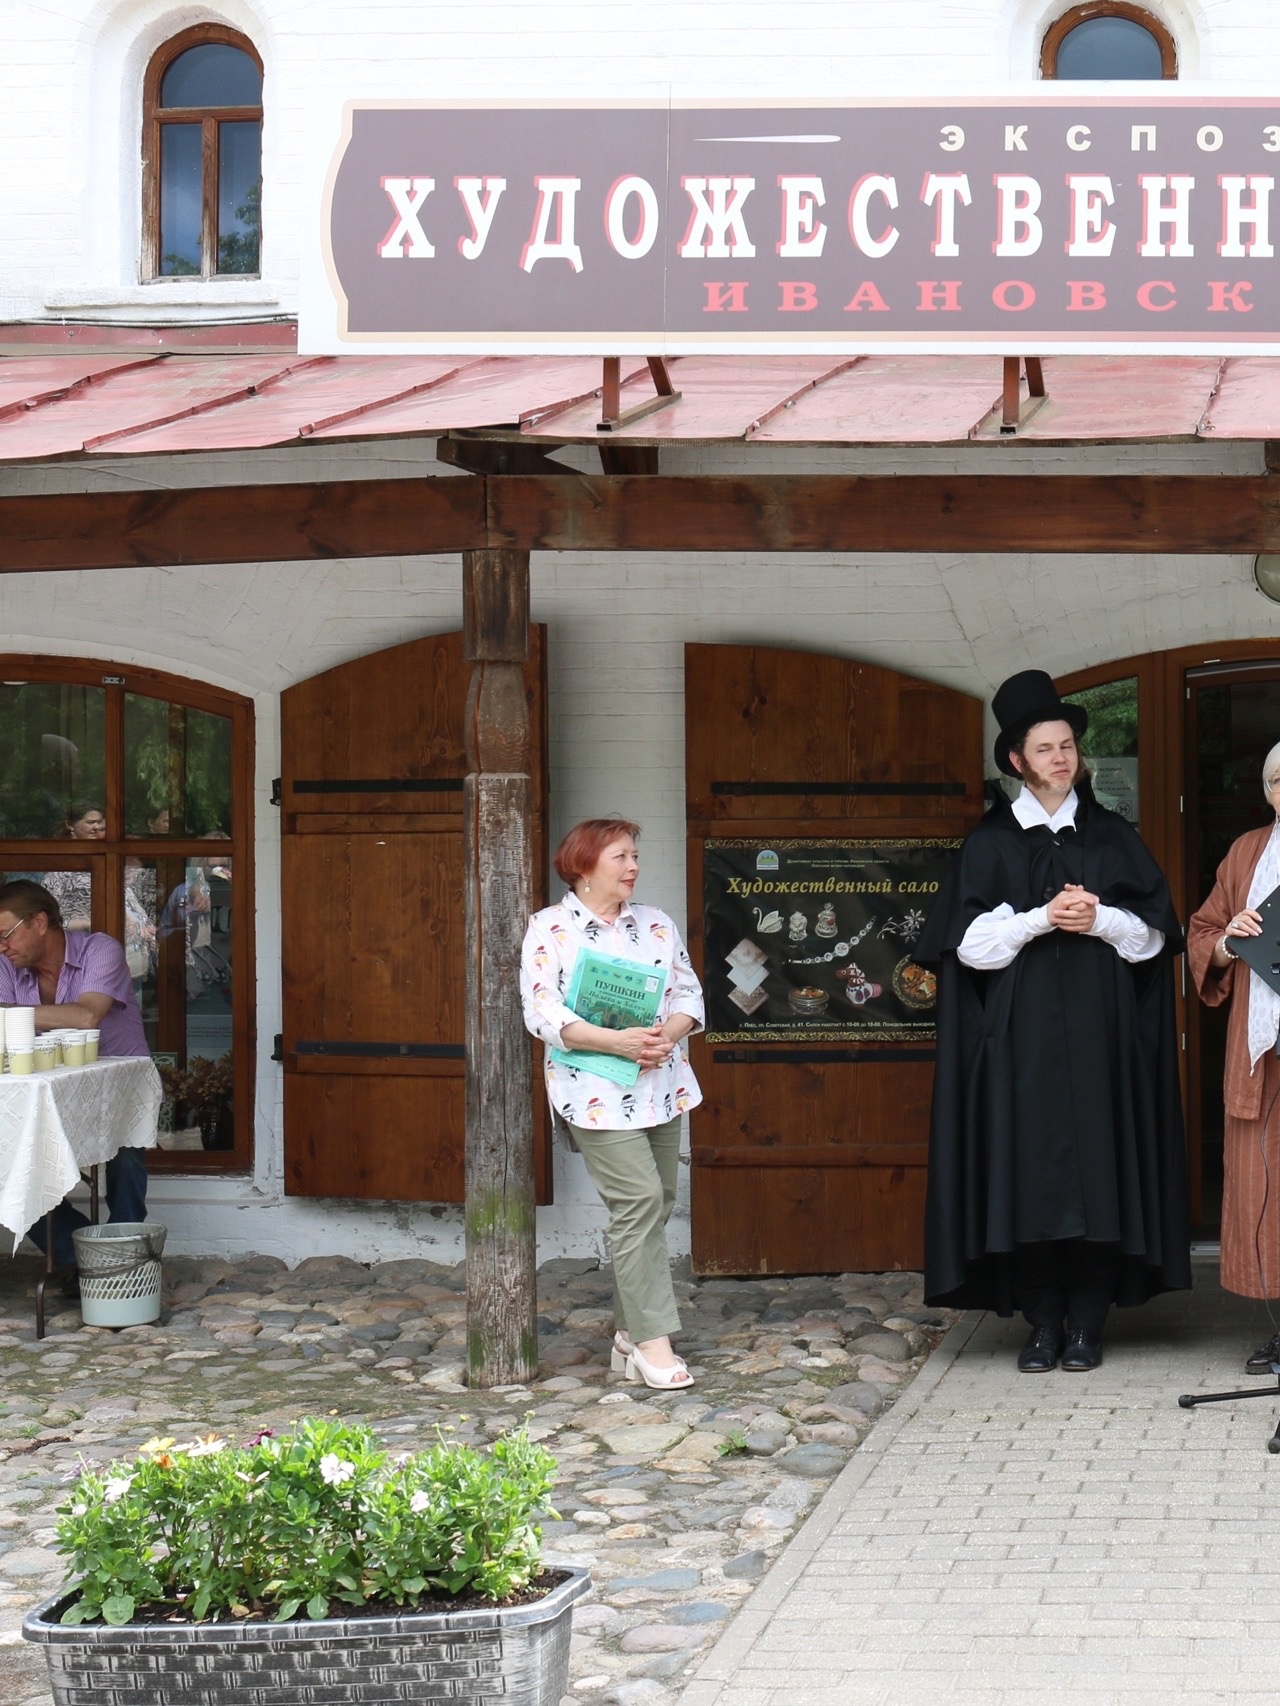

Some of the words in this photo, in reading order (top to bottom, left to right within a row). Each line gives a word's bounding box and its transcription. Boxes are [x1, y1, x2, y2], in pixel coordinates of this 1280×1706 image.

[726, 876, 892, 898] Художественный
[898, 881, 939, 893] сало
[594, 980, 646, 1000] ПУШКИН
